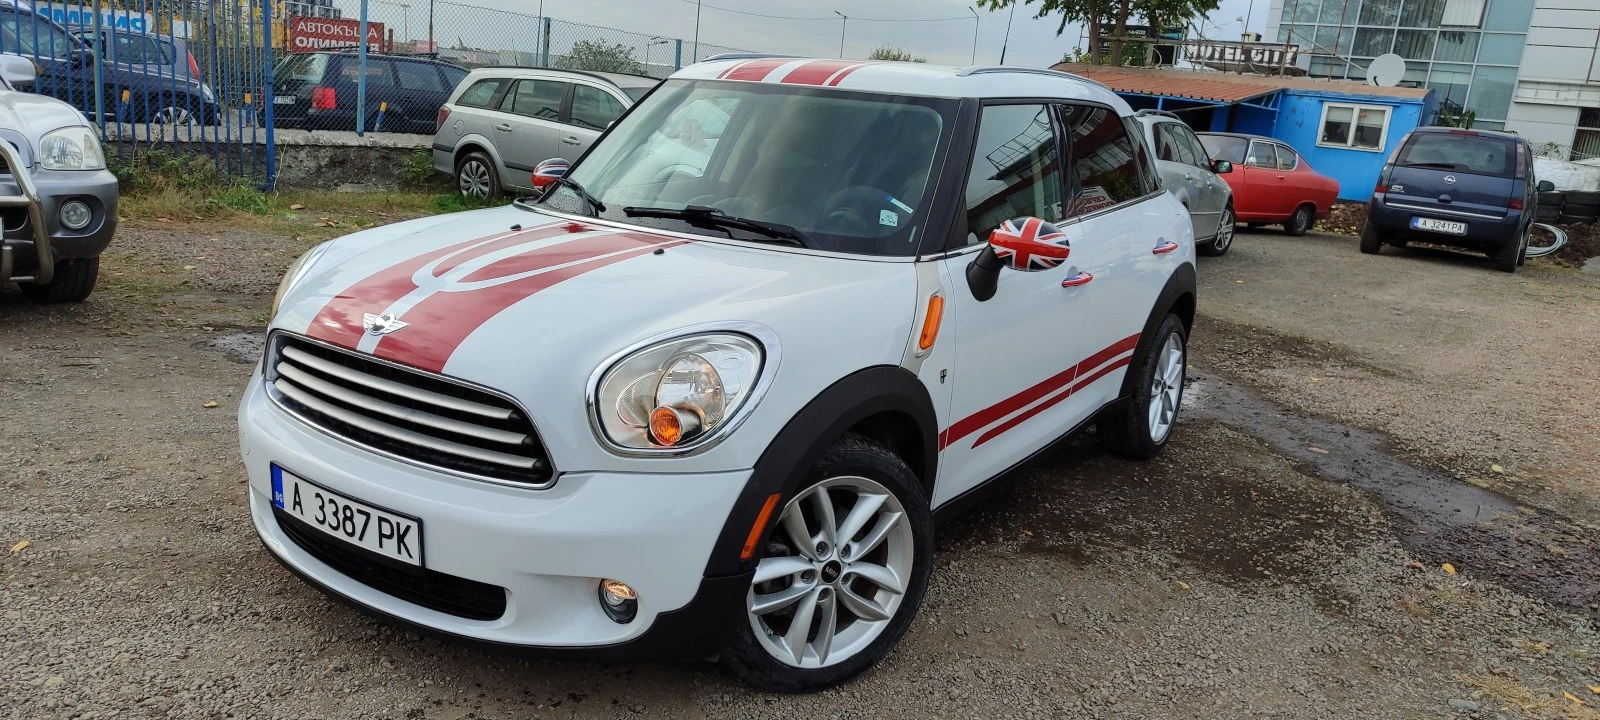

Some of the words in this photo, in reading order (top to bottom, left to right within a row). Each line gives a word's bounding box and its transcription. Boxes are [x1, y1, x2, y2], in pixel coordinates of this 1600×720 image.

[275, 491, 284, 503] BG
[293, 481, 304, 517] A
[315, 492, 371, 542] 3387
[378, 515, 414, 560] PK
